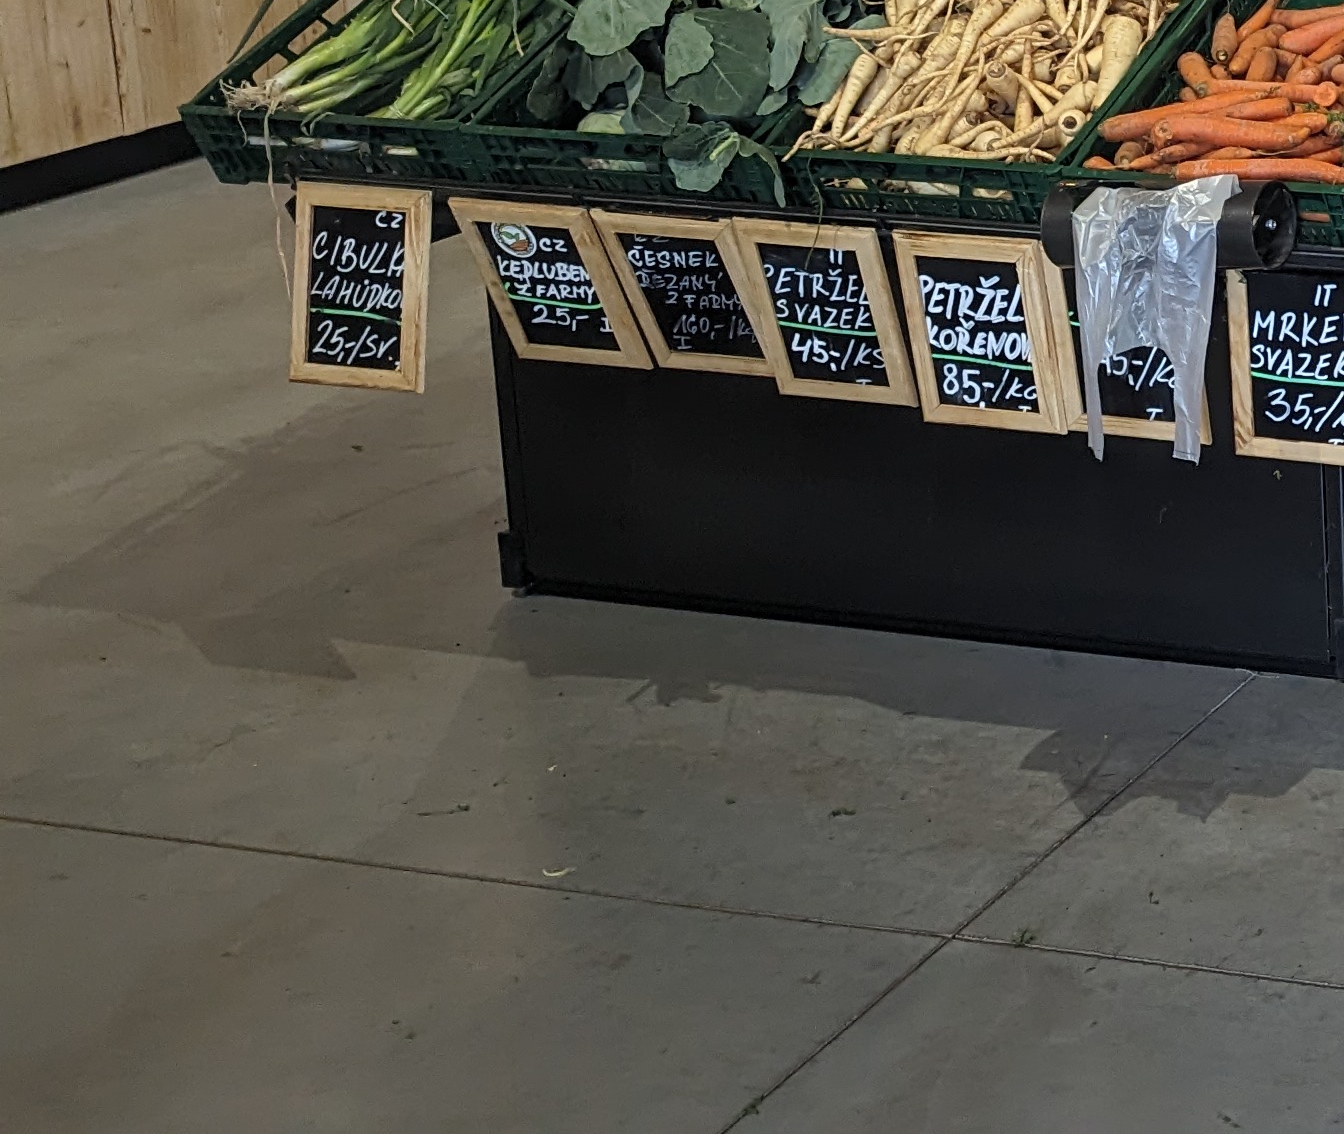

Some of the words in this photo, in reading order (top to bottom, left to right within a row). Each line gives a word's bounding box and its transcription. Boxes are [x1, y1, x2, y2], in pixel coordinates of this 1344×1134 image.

[375, 210, 403, 228] CZ
[539, 238, 568, 253] CZ
[628, 245, 718, 268] ČESNEK
[310, 271, 402, 312] LAHŮDKO
[536, 285, 595, 303] FARMY
[918, 275, 1025, 323] PETRŽEL
[1313, 284, 1338, 307] IT
[776, 298, 872, 330] SVAZEK
